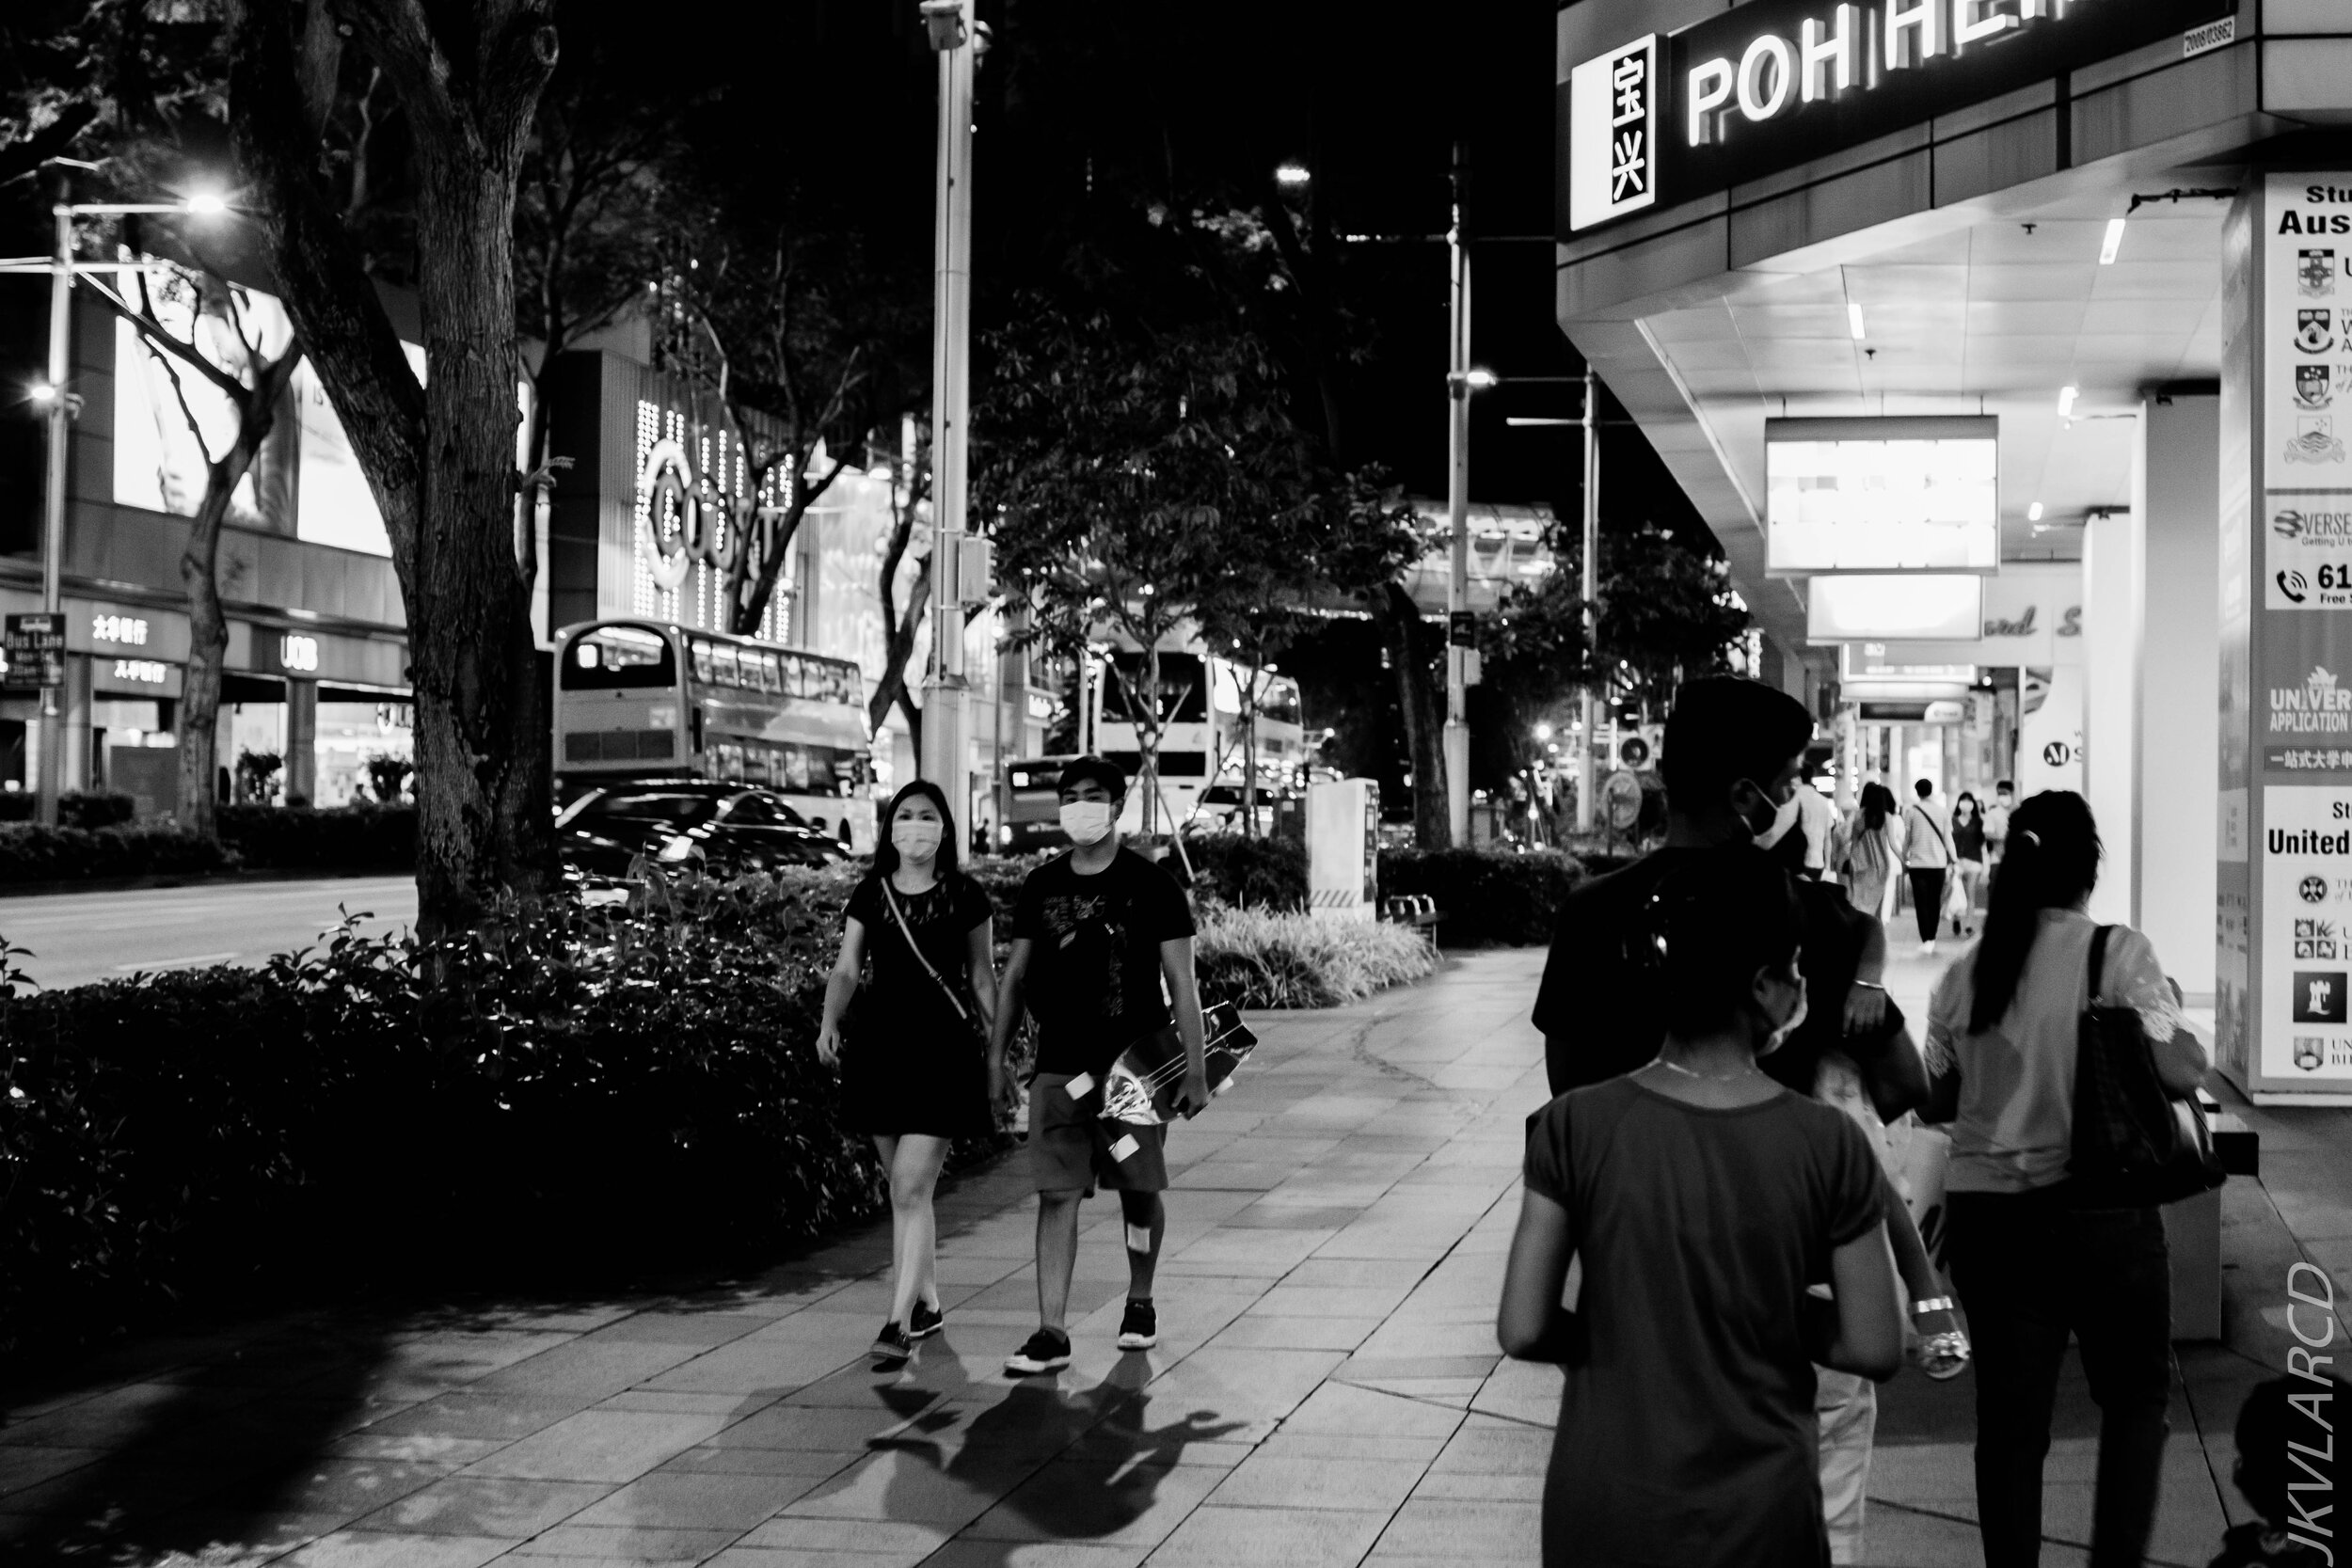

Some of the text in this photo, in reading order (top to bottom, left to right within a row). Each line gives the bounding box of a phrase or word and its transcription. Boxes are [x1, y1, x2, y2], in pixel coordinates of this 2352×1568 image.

[1689, 3, 1851, 147] POH
[1612, 56, 1645, 201] 宝兴
[2278, 210, 2351, 234] Aus
[2301, 536, 2335, 547] Getting
[2320, 593, 2346, 604] Free
[7, 631, 63, 650] Bus Lane
[2269, 711, 2348, 732] APPLICATION
[2268, 829, 2350, 855] United
